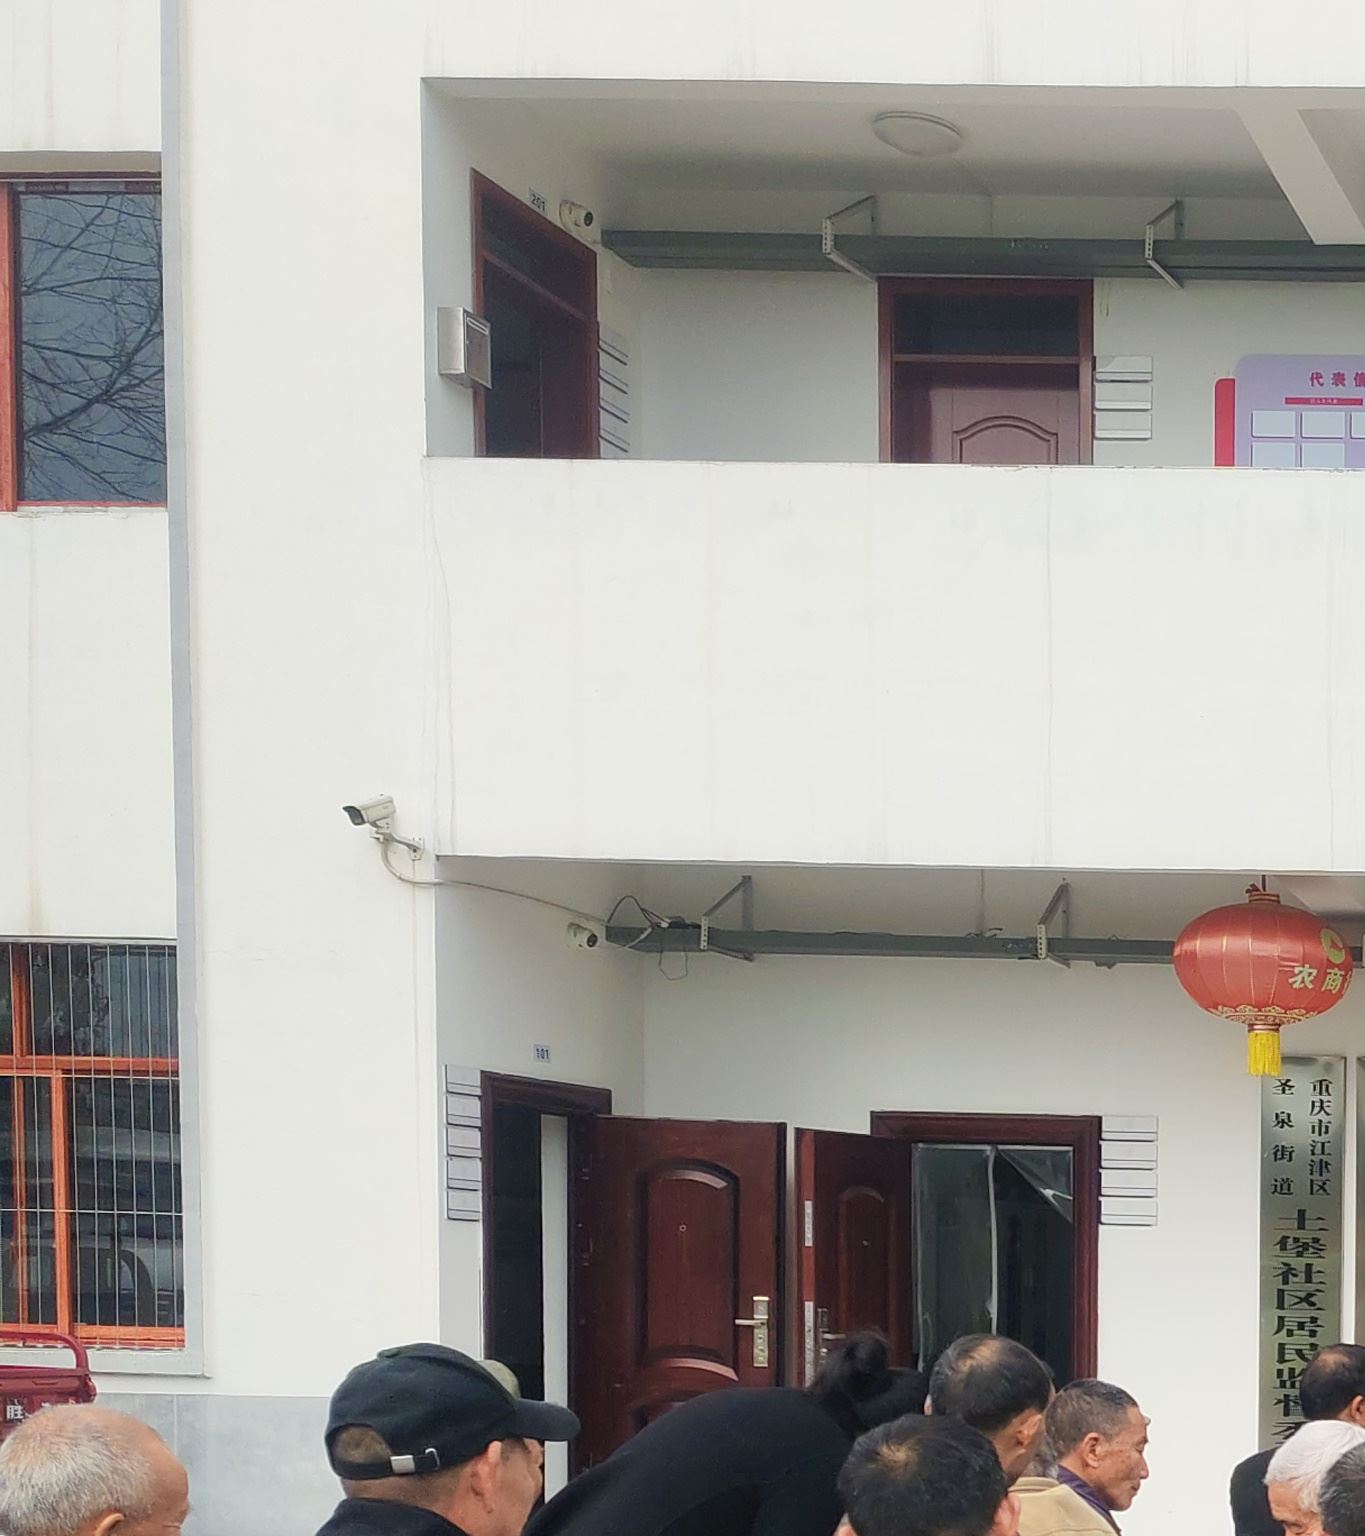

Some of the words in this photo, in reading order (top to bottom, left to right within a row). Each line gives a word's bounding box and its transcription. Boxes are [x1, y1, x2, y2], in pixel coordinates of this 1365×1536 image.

[1270, 1077, 1295, 1196] 圣泉街道
[1309, 1078, 1334, 1197] 重庆市江津区
